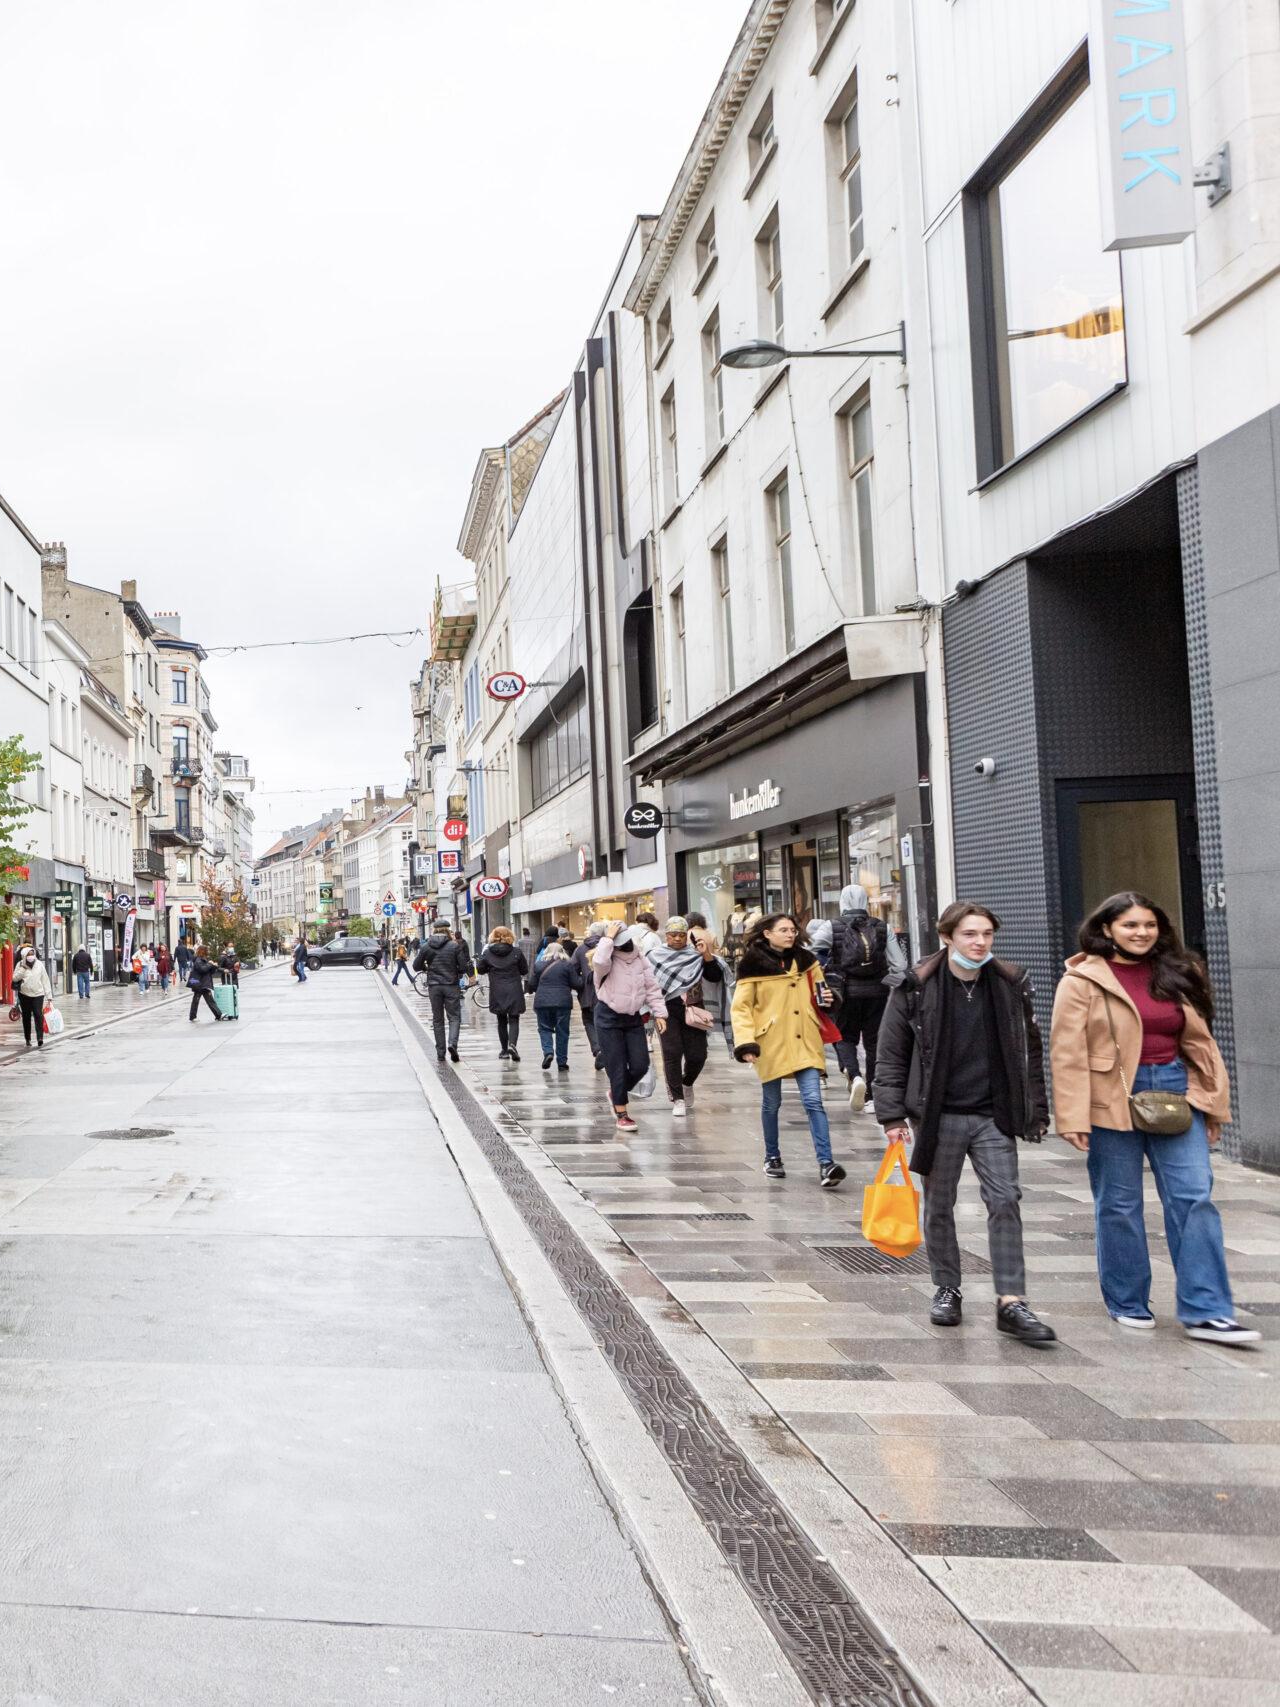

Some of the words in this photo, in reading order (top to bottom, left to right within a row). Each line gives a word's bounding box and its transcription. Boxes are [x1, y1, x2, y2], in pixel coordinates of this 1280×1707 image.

[493, 679, 519, 693] C&A
[729, 778, 782, 821] hunkemöller
[482, 881, 503, 893] C&A
